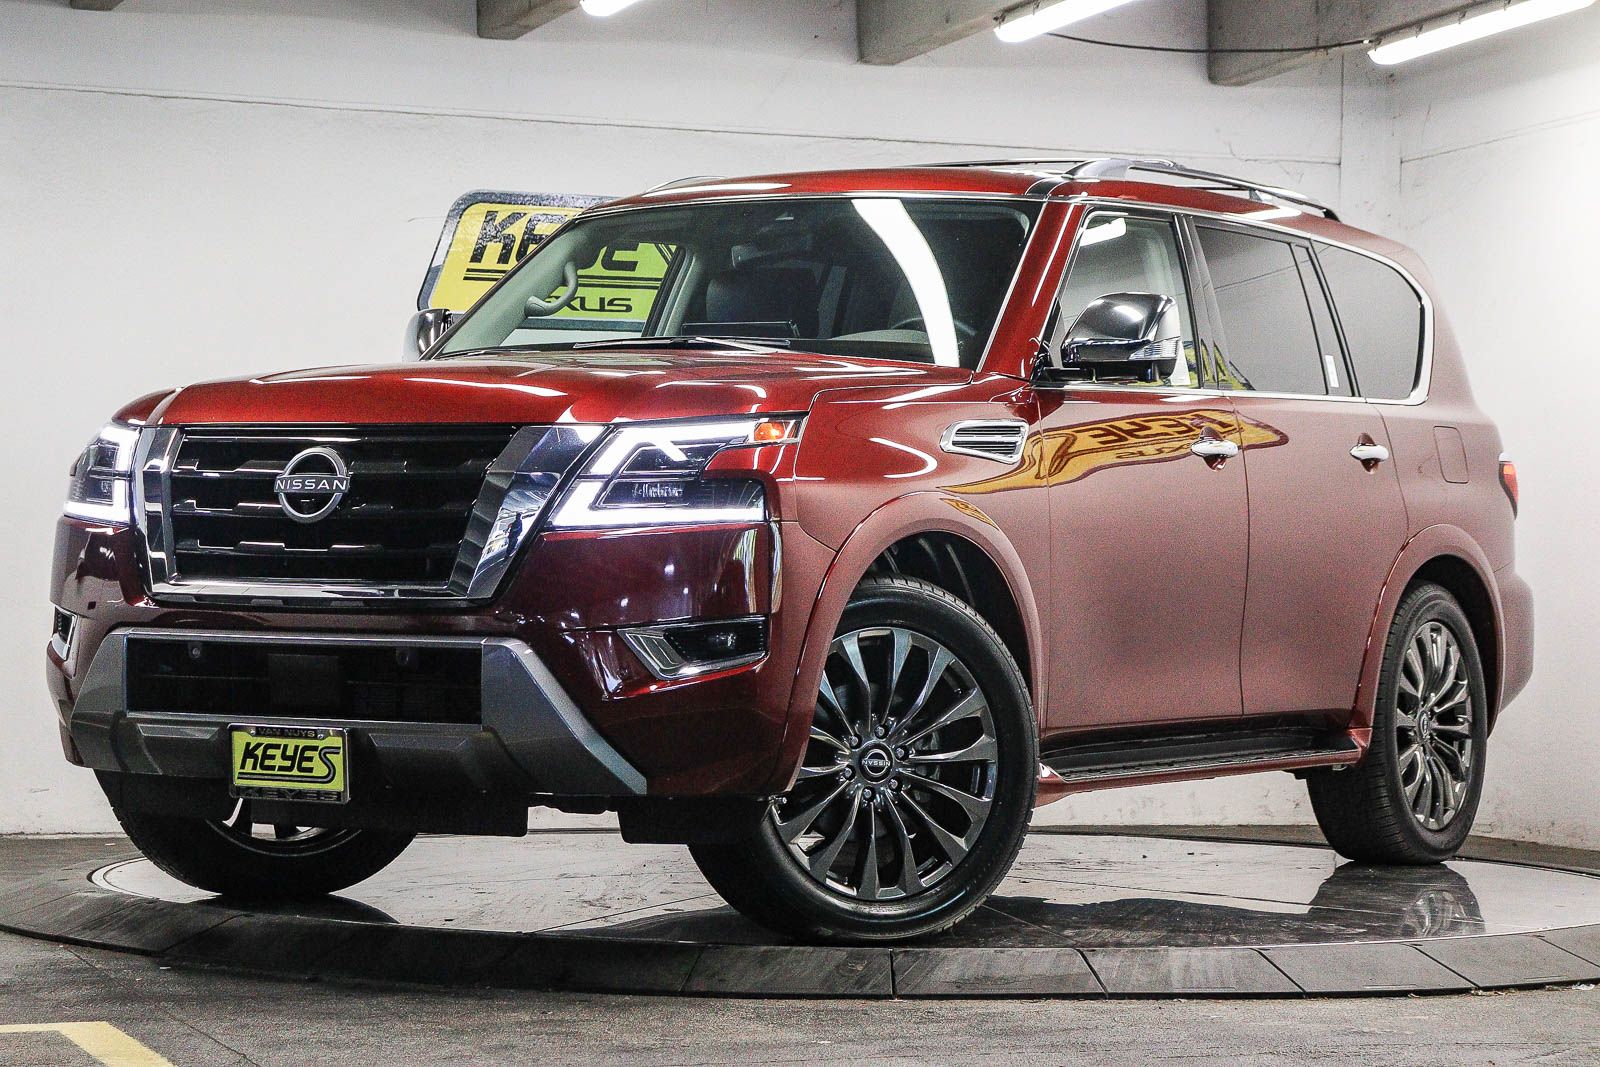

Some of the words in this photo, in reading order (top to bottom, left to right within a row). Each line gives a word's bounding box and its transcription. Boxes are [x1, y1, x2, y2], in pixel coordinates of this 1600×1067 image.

[275, 479, 347, 490] NISSAN
[258, 727, 282, 736] VAN
[284, 728, 316, 738] NUYS
[237, 741, 341, 784] KEYES
[861, 759, 891, 767] NISSAN
